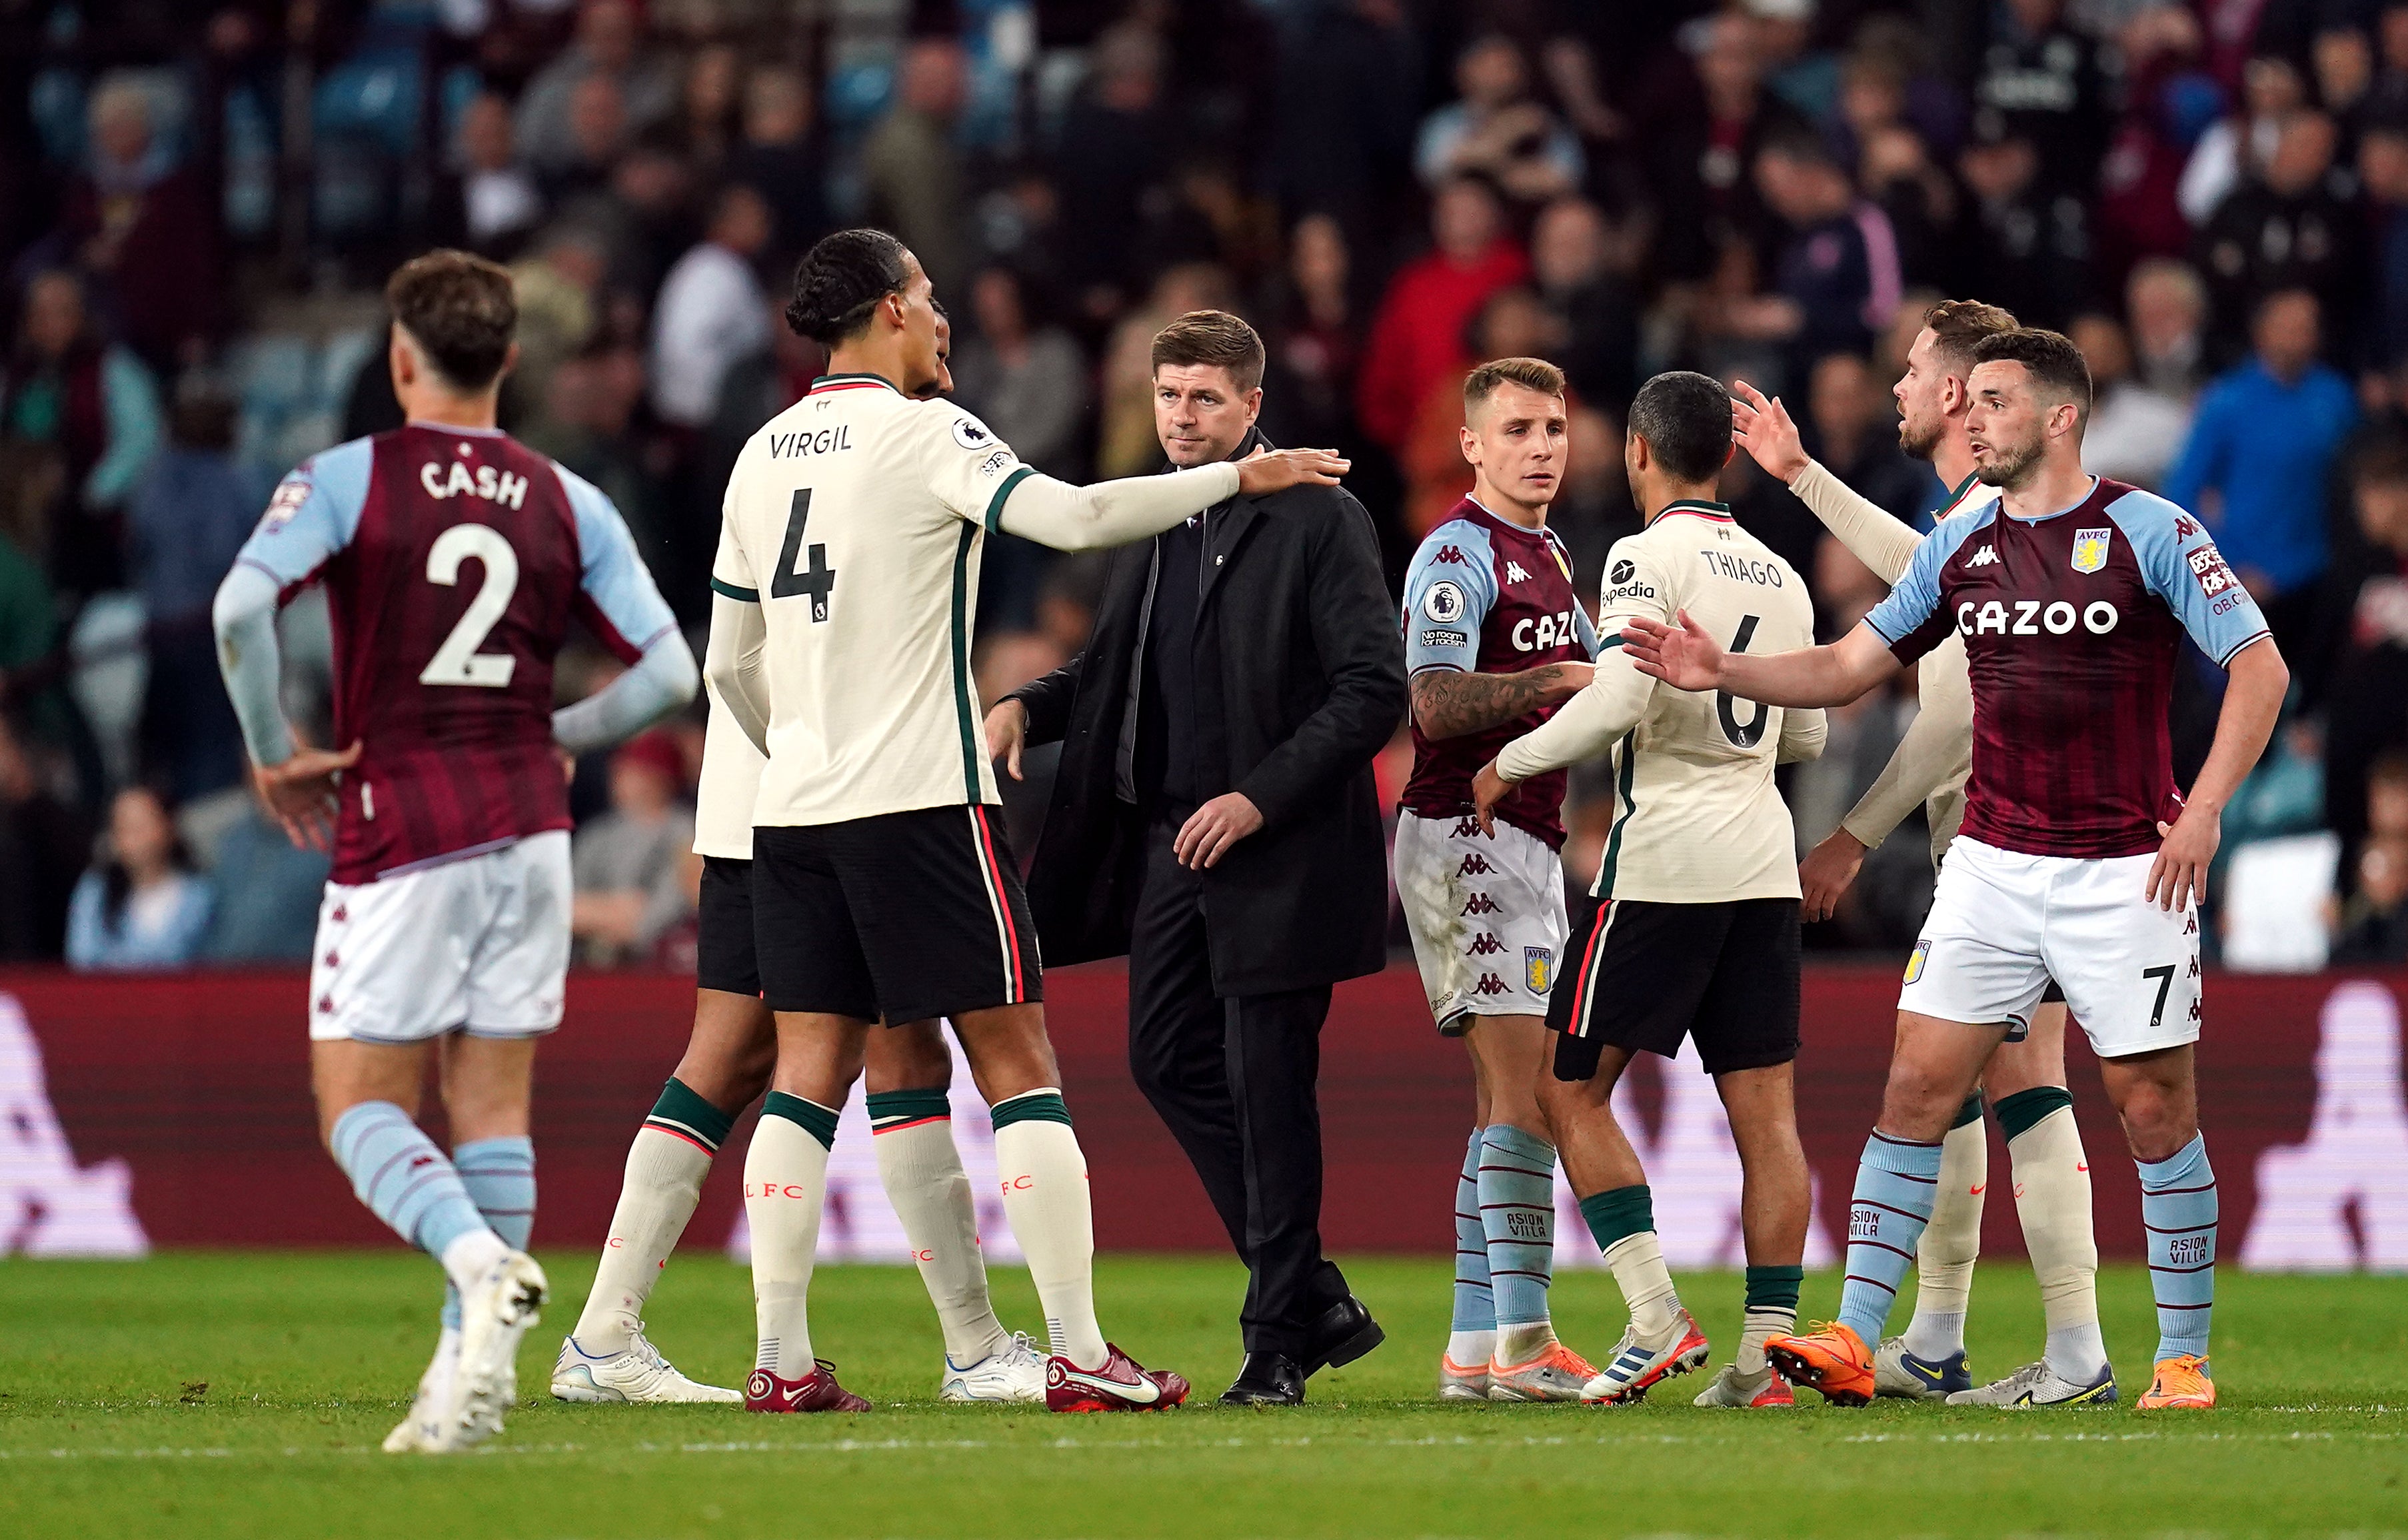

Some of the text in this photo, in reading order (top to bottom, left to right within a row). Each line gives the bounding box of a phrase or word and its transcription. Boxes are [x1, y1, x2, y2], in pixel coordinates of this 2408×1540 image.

[771, 425, 851, 458] VIRGIL
[421, 461, 529, 511] CASH
[2079, 530, 2108, 540] AVFC
[771, 488, 836, 623] 4
[1701, 551, 1782, 588] THIAGO
[418, 522, 519, 688] 2
[1957, 600, 2118, 635] CAZOO
[2213, 592, 2249, 615] OB.C
[1422, 631, 1463, 640] No room
[1717, 614, 1769, 748] 6
[1527, 948, 1550, 960] AVFC
[2143, 964, 2176, 1027] 7
[2170, 1235, 2207, 1251] ASTON
[2170, 1249, 2205, 1264] VILLA
